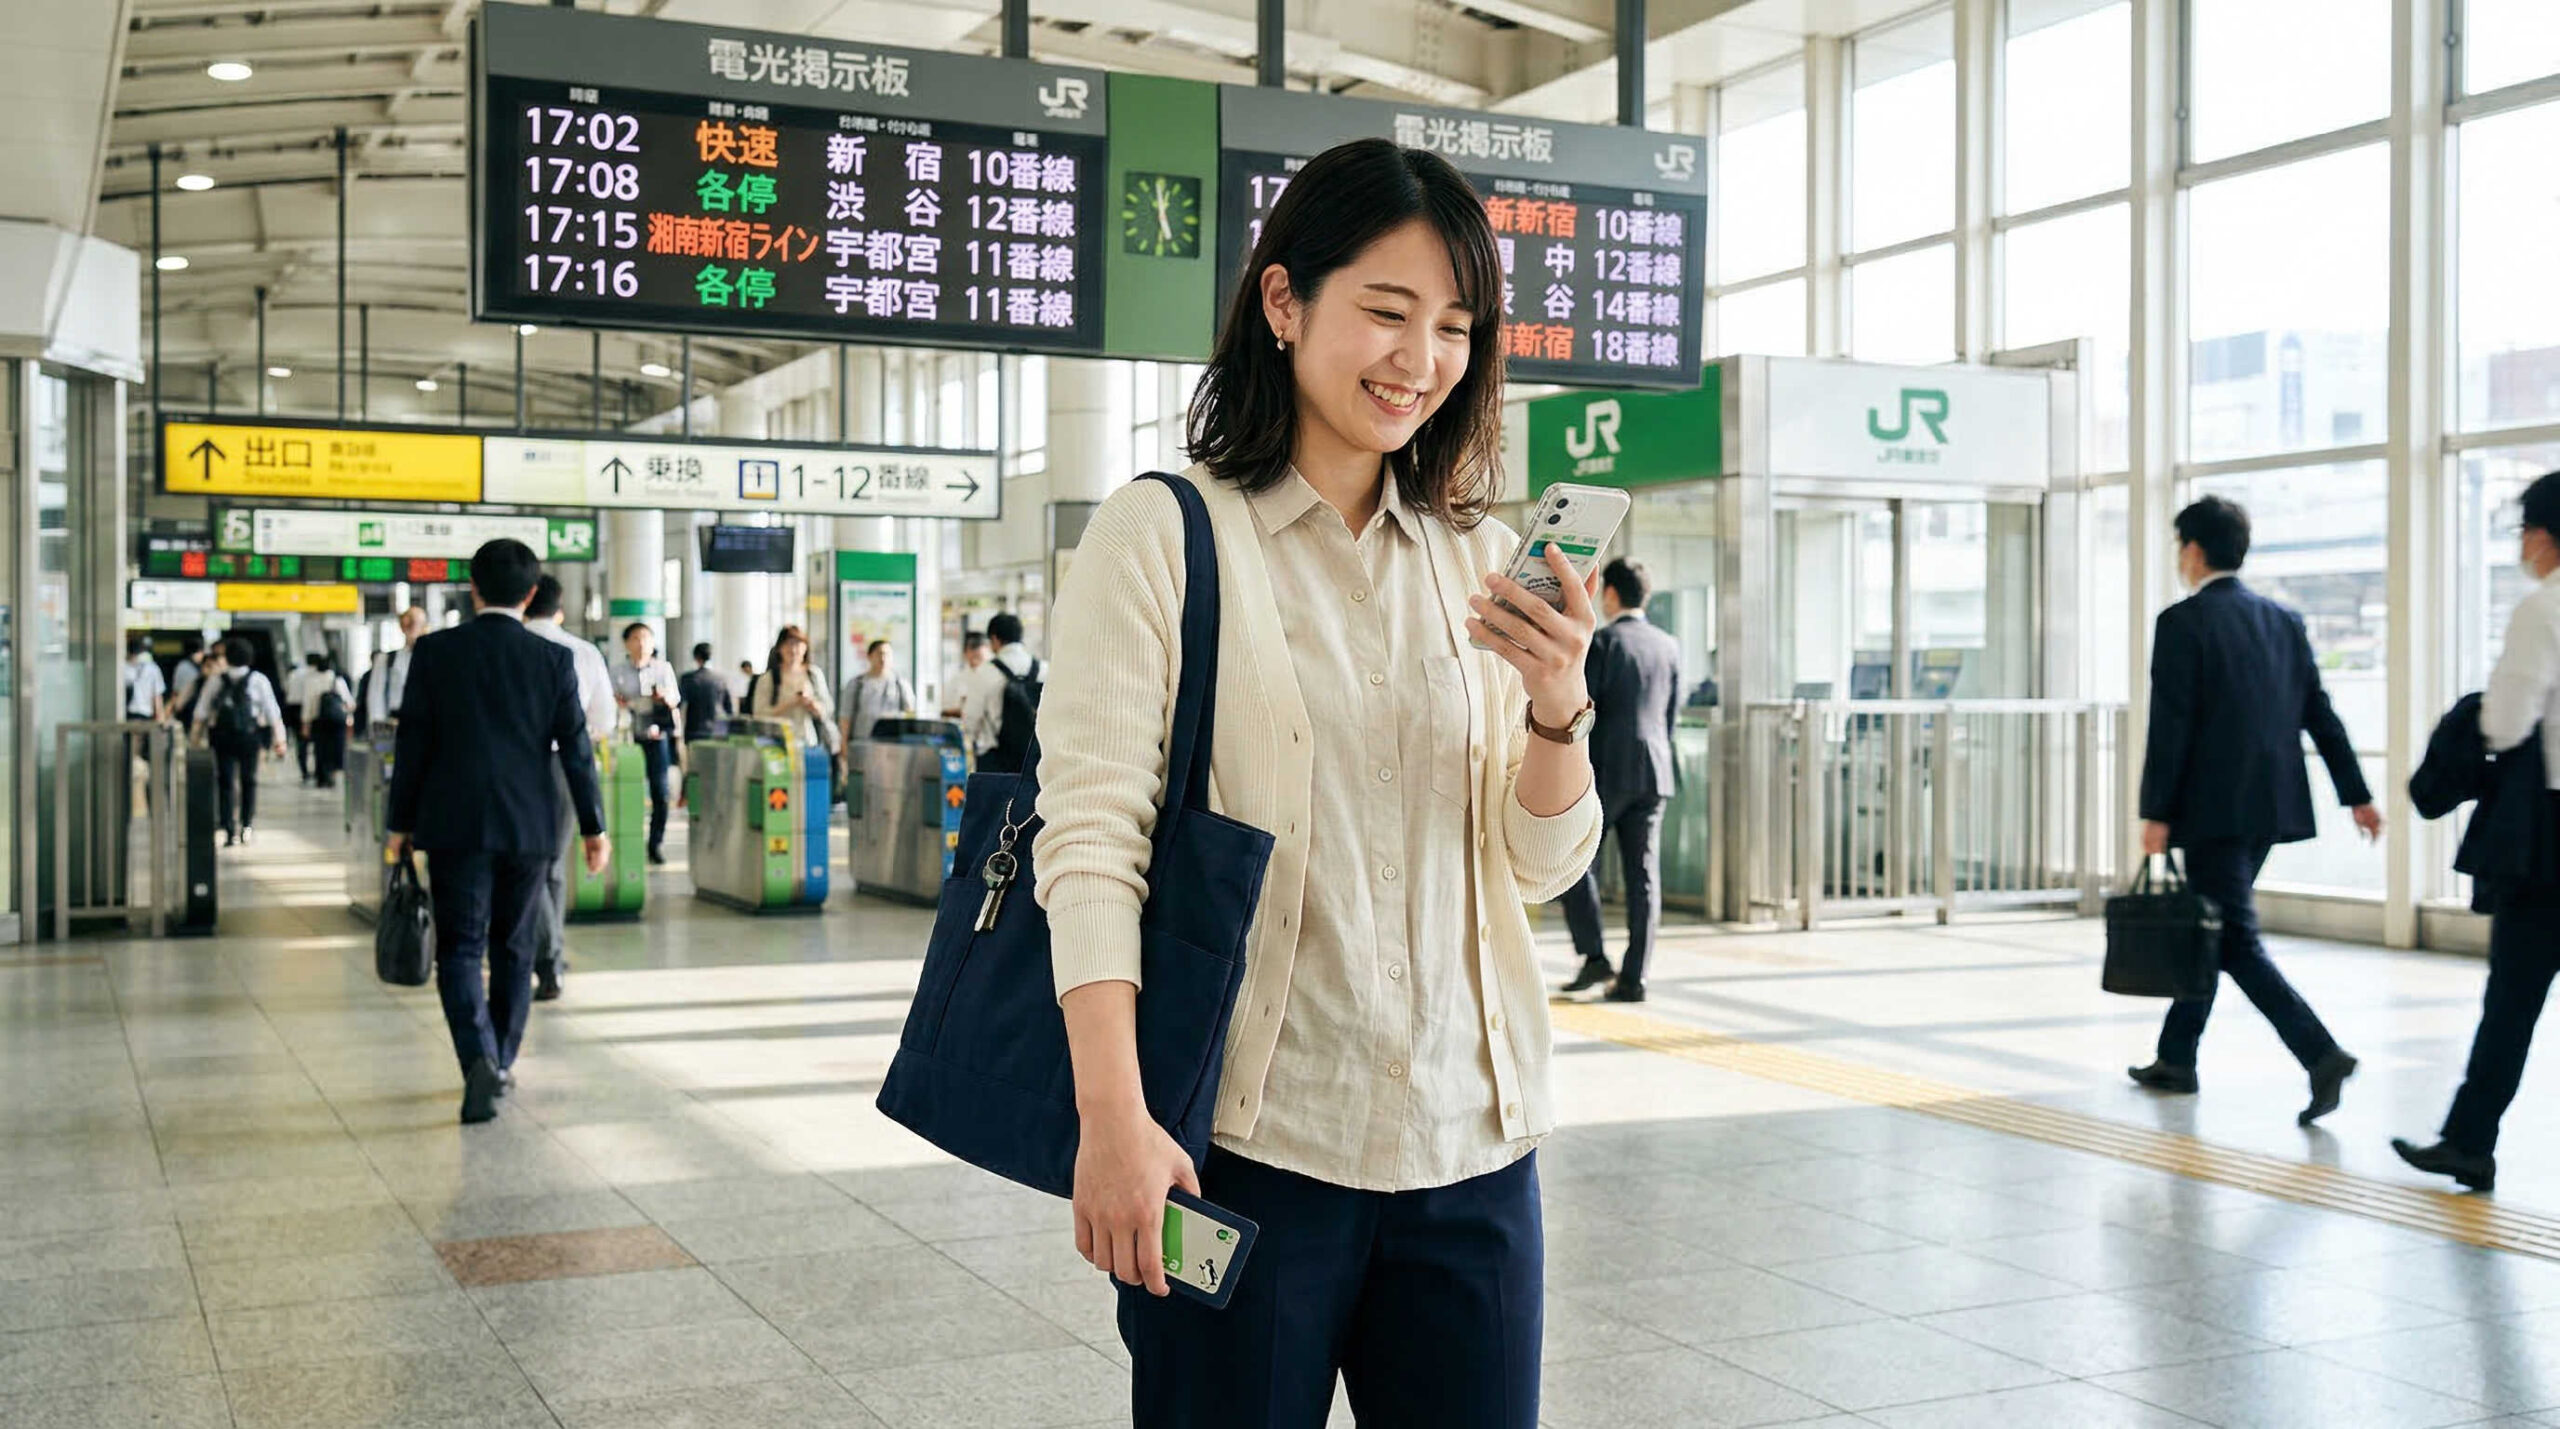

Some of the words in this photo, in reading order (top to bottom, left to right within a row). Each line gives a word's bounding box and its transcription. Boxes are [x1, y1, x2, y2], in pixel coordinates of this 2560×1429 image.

[708, 38, 910, 97] 電光掲示板
[1039, 77, 1088, 110] JR
[526, 107, 640, 153] 17:02
[696, 120, 779, 168] 快速
[968, 150, 1076, 193] 10番線
[1394, 113, 1554, 163] 電光掲示板
[1654, 145, 1696, 173] JR
[525, 156, 640, 201] 17:08
[697, 168, 778, 214] 各停
[967, 195, 1075, 238] 12番線
[525, 204, 639, 249] 17:15
[647, 212, 819, 262] 湘南新宿ライン
[825, 227, 942, 274] 宇都宮
[966, 240, 1075, 282] 11番線
[1595, 208, 1682, 246] 10番線
[1594, 249, 1681, 287] 12番線
[524, 254, 639, 298] 17:16
[695, 263, 776, 309] 各停
[825, 273, 941, 320] 宇都宮
[965, 286, 1074, 328] 11番線
[1592, 289, 1680, 327] 14番線
[1592, 329, 1679, 367] 18番線
[1566, 399, 1622, 459] JR
[1868, 388, 1949, 444] JR
[245, 436, 312, 467] 出口
[550, 523, 593, 549] JR
